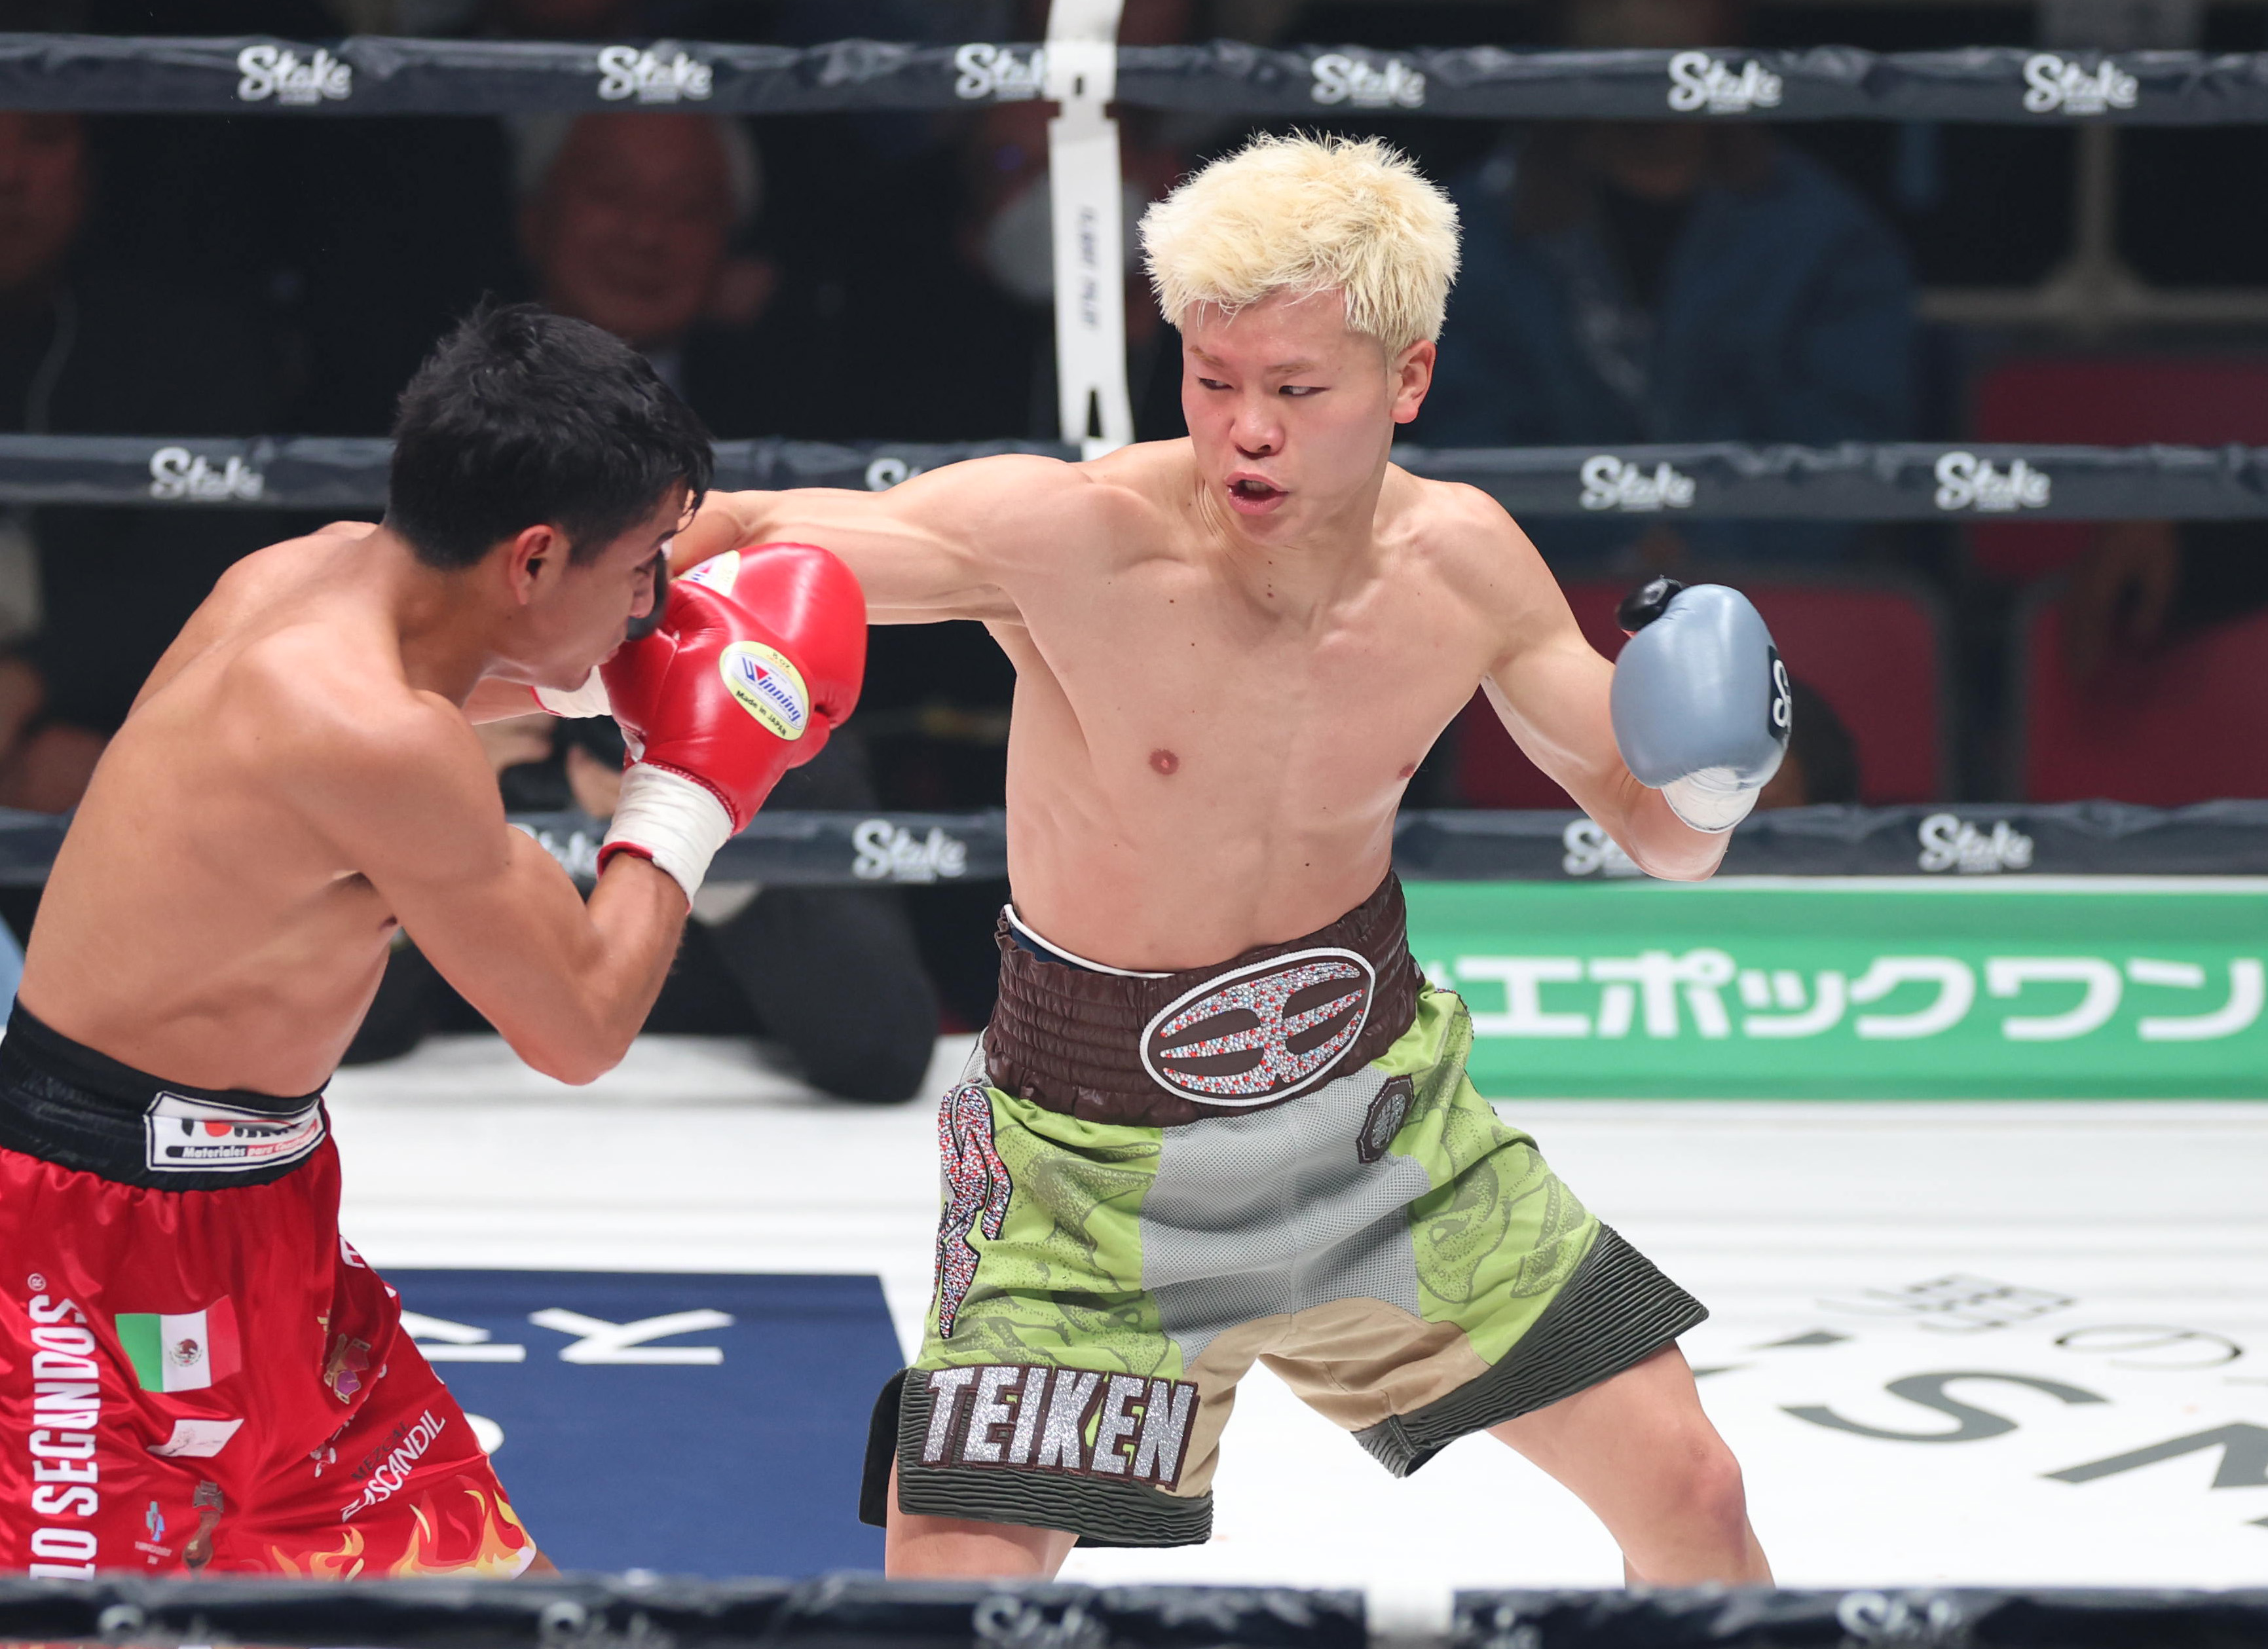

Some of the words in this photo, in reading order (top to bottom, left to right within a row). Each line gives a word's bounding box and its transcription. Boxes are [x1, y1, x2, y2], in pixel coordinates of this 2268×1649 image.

[238, 45, 352, 101] Stake
[599, 46, 713, 100] Stake
[1311, 54, 1425, 108] Stake
[1668, 51, 1783, 111] Stake
[2023, 54, 2138, 113] Stake
[149, 447, 264, 499] Stake
[1580, 455, 1695, 510] Stake
[1934, 451, 2051, 510] Stake
[735, 690, 758, 709] Made
[759, 706, 767, 716] in
[768, 714, 787, 736] JAPAN
[742, 657, 802, 722] Winning
[852, 819, 966, 880] Stake
[1918, 812, 2033, 871] Stake
[1428, 948, 2263, 1041] エポックワン
[182, 1146, 246, 1157] Materiales
[923, 1365, 1195, 1482] TEIKEN
